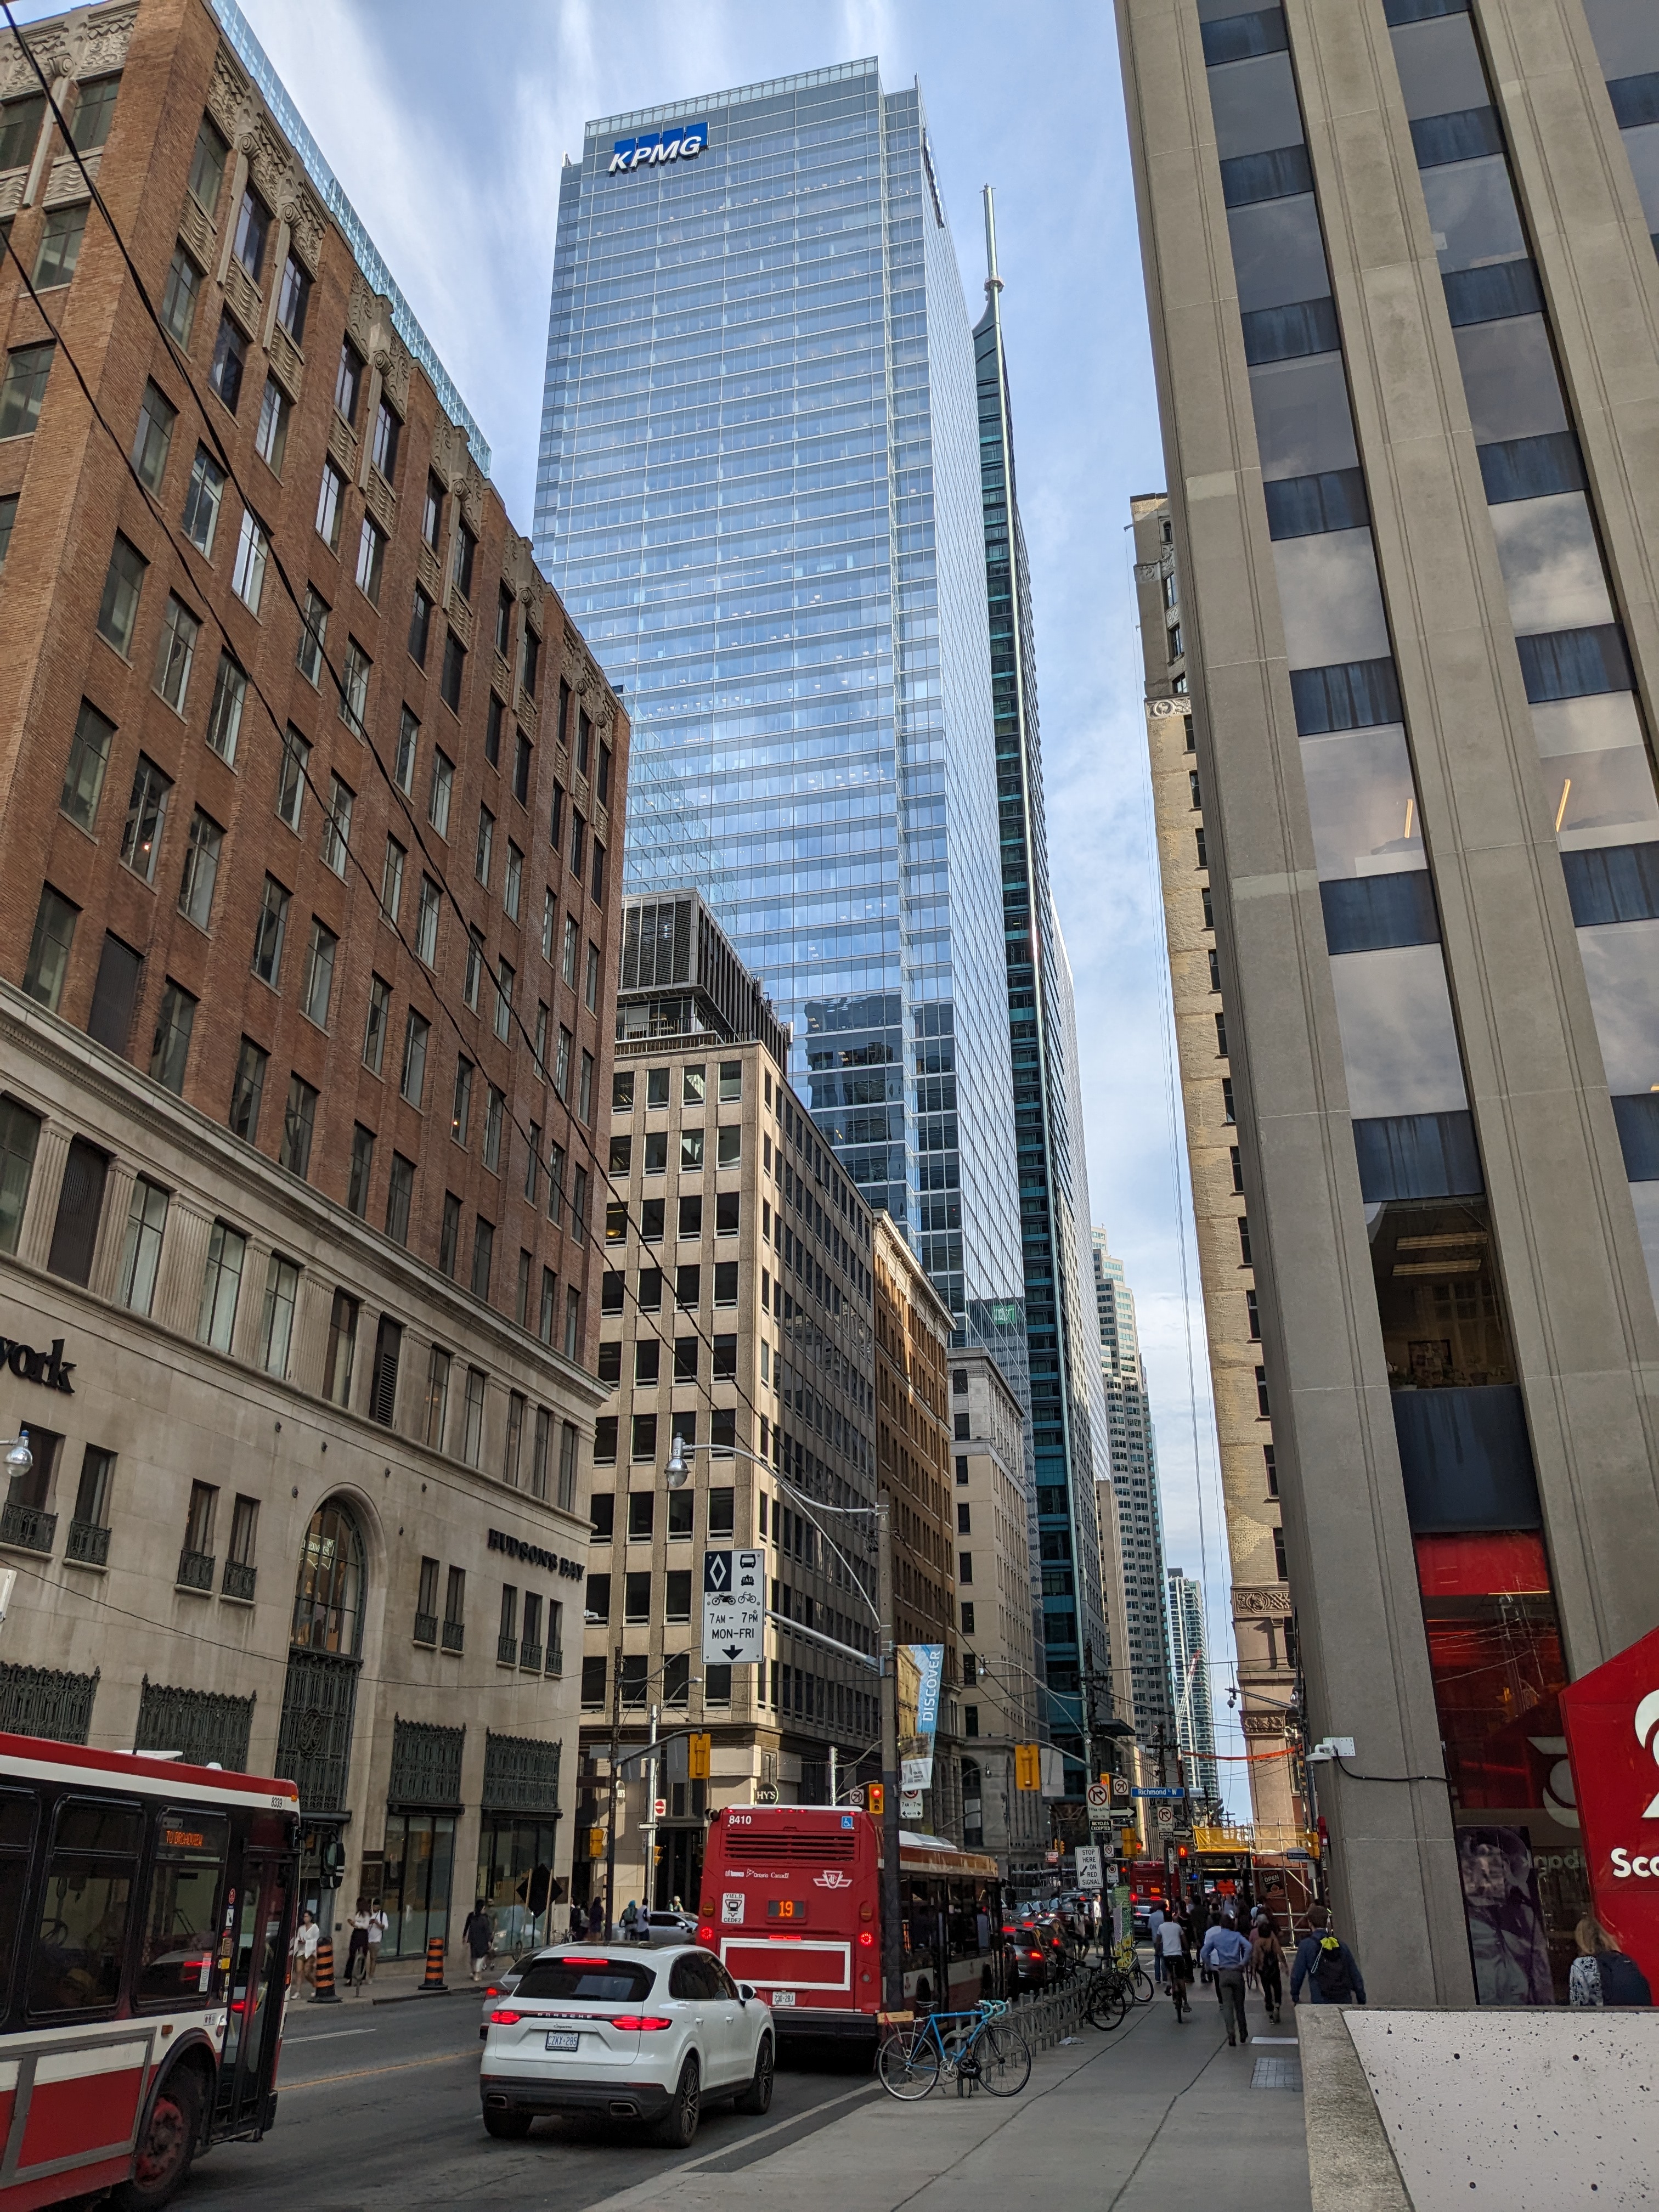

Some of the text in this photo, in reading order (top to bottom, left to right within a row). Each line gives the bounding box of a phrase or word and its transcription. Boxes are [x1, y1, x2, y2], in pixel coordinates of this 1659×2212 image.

[608, 136, 702, 172] KPMG
[559, 1557, 585, 1581] BAY
[712, 1628, 754, 1639] MON-FRI
[922, 1651, 941, 1722] DISCOVER
[271, 1797, 283, 1808] 8339
[729, 1815, 752, 1825] 8410
[1264, 1874, 1279, 1883] OPEN
[779, 1900, 793, 1917] 19
